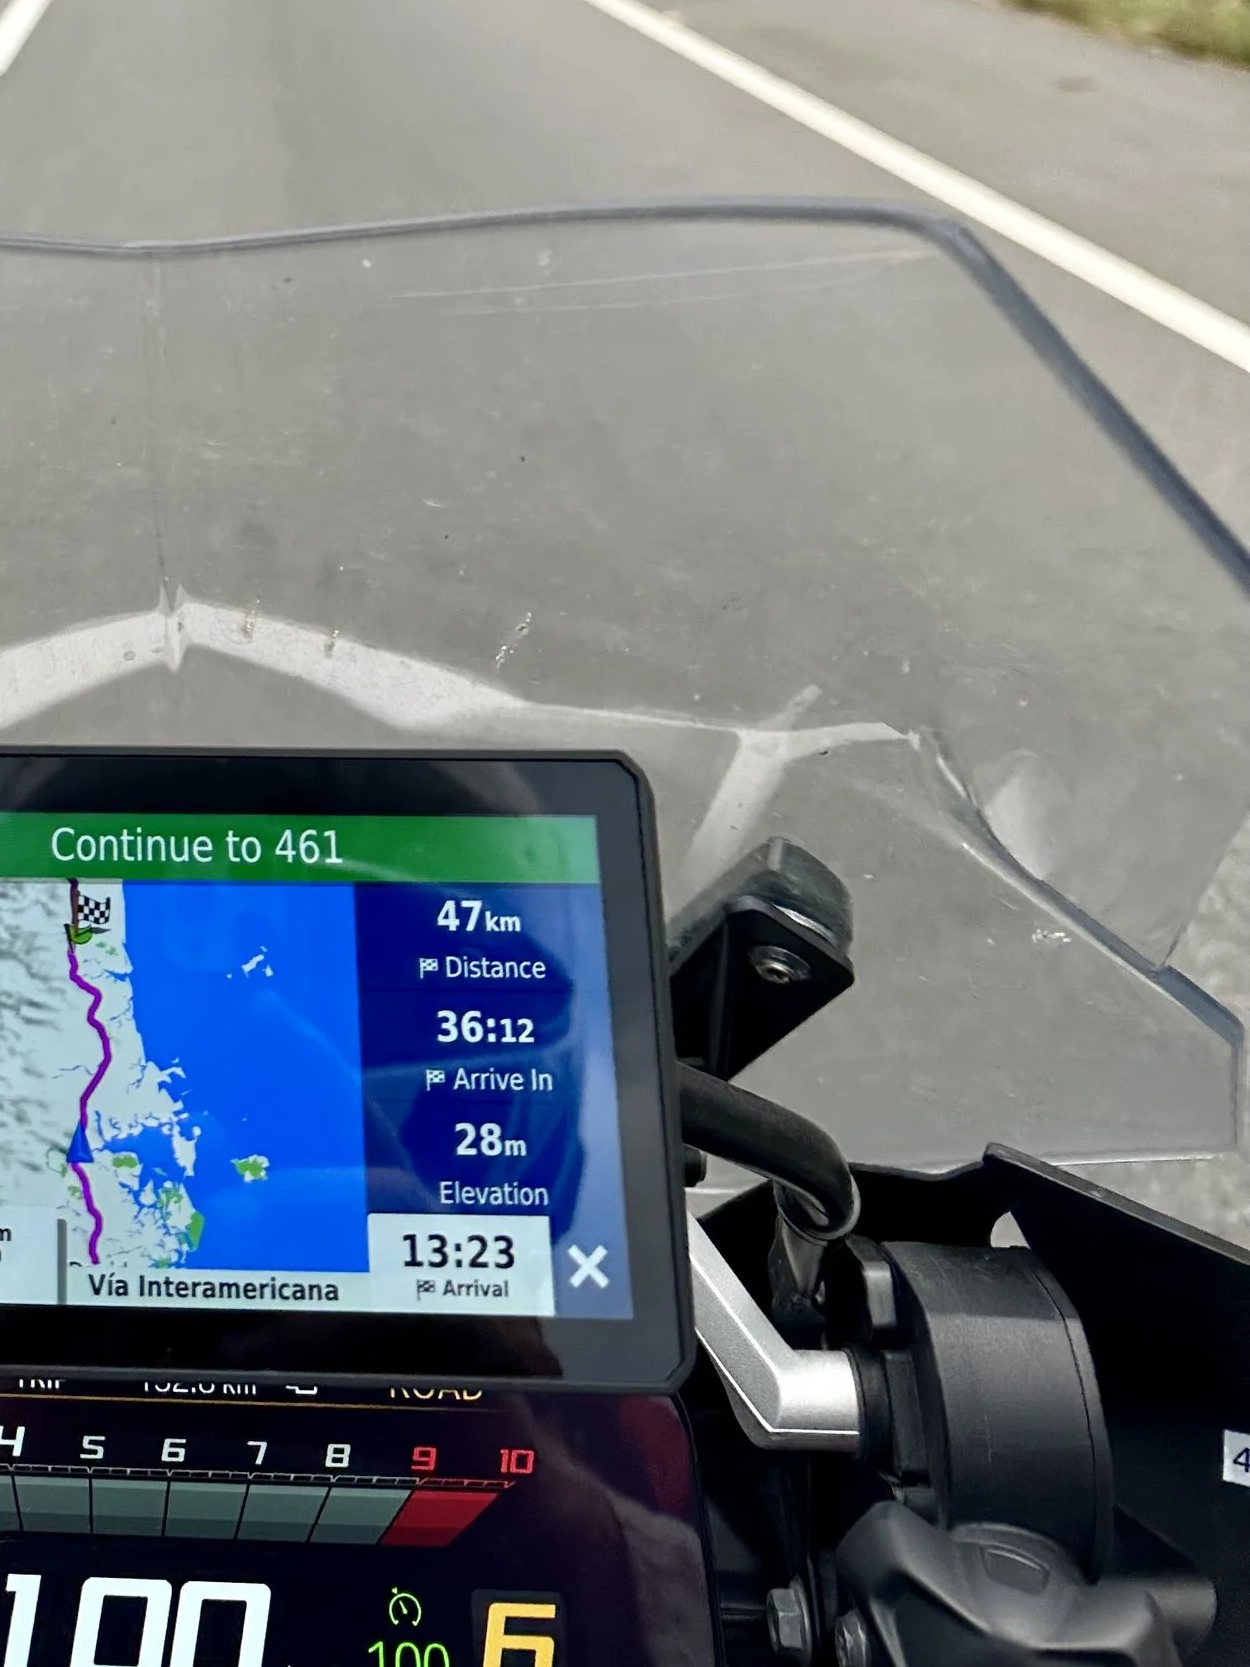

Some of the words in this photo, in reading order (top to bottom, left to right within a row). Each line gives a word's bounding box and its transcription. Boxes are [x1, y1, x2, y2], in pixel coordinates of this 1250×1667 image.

[51, 826, 213, 863] Continue
[226, 830, 262, 864] to
[275, 829, 343, 864] 461
[445, 956, 546, 979] Distance
[437, 1010, 535, 1043] 36:12
[453, 1067, 524, 1091] Arrive
[532, 1068, 553, 1091] In
[439, 1181, 550, 1207] Elevation
[402, 1234, 515, 1268] 13:23
[88, 1273, 129, 1297] Vía
[138, 1274, 339, 1301] Interamericana
[442, 1279, 509, 1298] Arrival
[80, 1436, 106, 1460] 5
[161, 1438, 187, 1462] 6
[247, 1441, 268, 1465] 7
[325, 1443, 351, 1468] 8
[411, 1446, 437, 1471] 9
[500, 1449, 535, 1474] 10
[484, 1602, 556, 1667] 6
